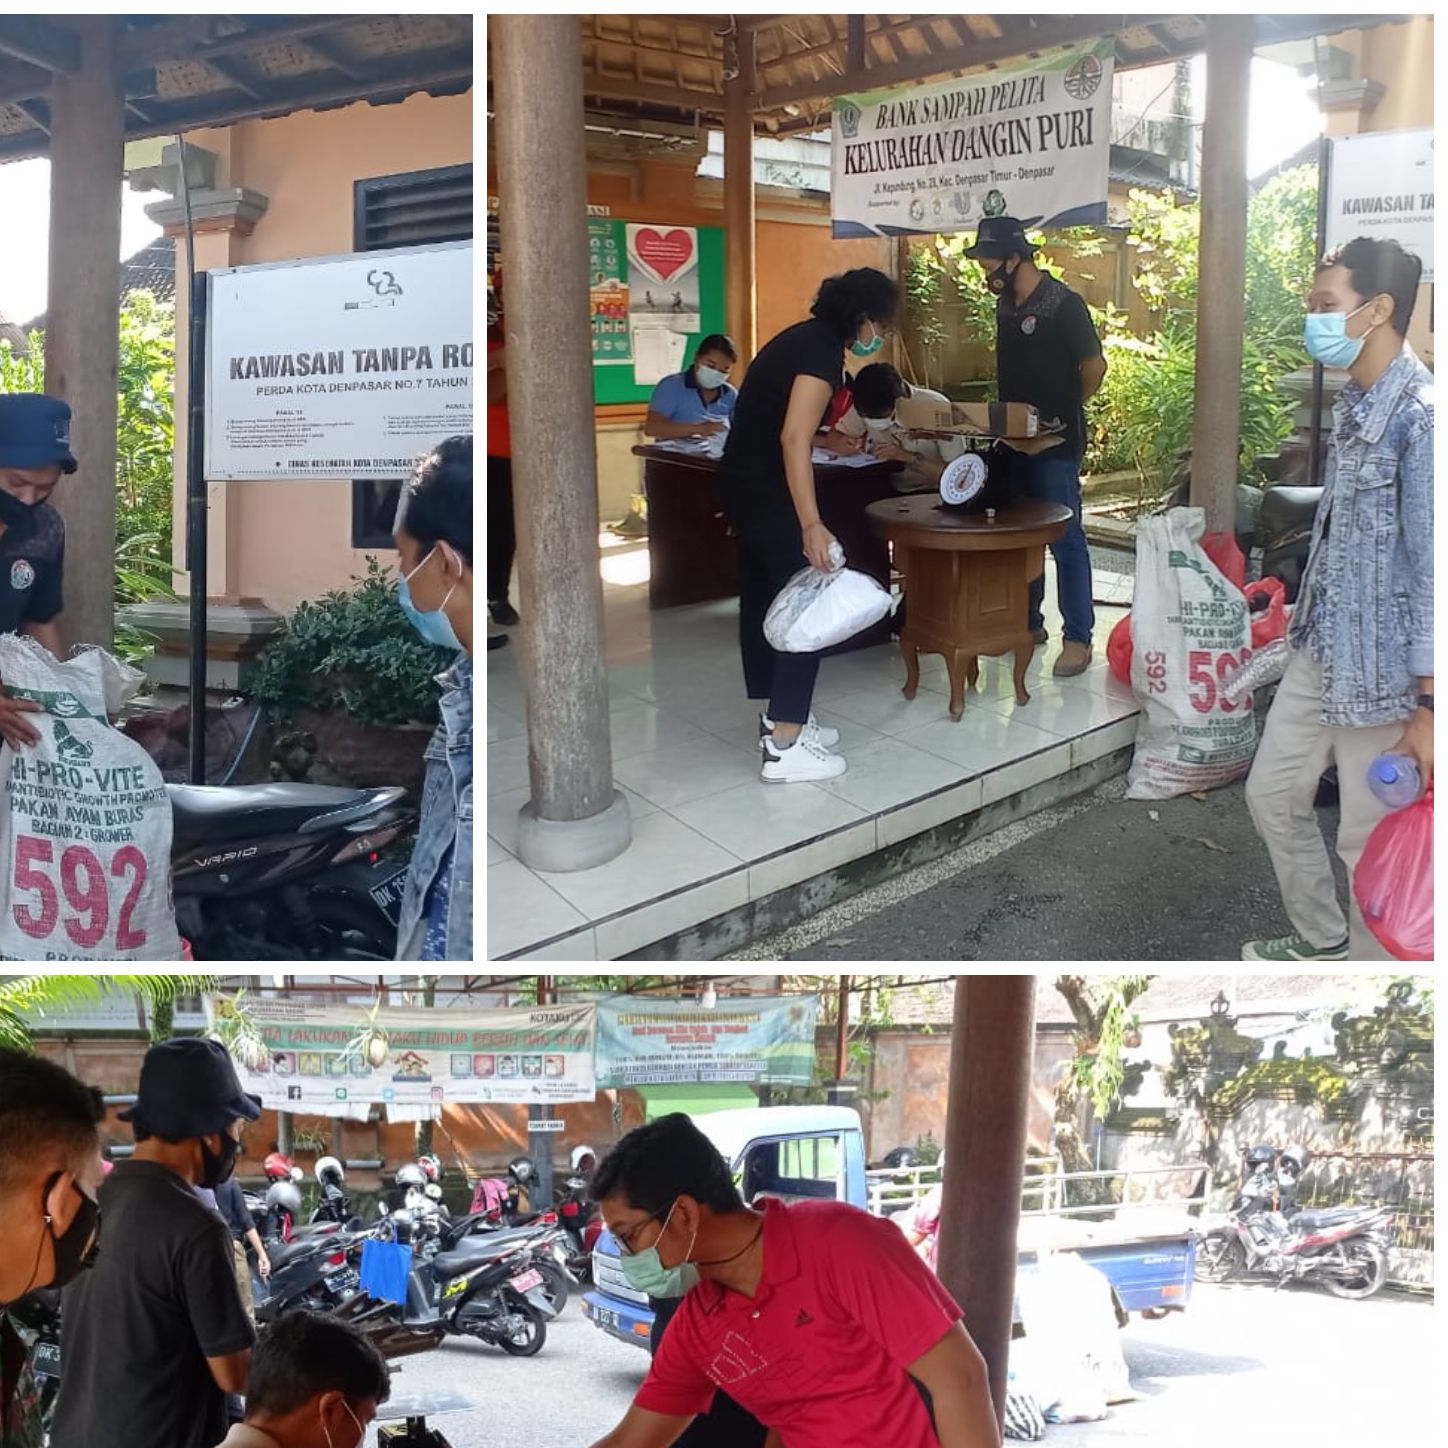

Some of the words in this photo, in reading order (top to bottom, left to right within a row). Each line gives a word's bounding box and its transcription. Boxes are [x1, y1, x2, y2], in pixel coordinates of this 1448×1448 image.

[876, 100, 919, 130] BANK
[920, 87, 986, 123] SAMPAH
[989, 75, 1045, 113] PELITA
[844, 130, 947, 176] KELURAHAN
[951, 117, 1032, 162] DANGIN
[1037, 107, 1095, 151] PURI
[955, 172, 988, 188] Denpasar
[991, 169, 1012, 182] Timur
[1018, 165, 1055, 182] Denpasar
[1342, 194, 1415, 215] KAWASAN
[230, 350, 344, 380] KAWASAN
[352, 345, 433, 373] TANPA
[256, 385, 294, 397] PERDA
[296, 383, 327, 394] KOTA
[329, 380, 392, 394] DENPASAR
[427, 376, 468, 388] TAHUN
[1145, 651, 1167, 694] 592
[10, 796, 59, 820] PAKAN
[65, 805, 101, 826] AYAM
[104, 806, 145, 826] BURAS
[90, 827, 134, 843] GROWER
[194, 847, 258, 867] VARIO
[12, 834, 148, 951] 592
